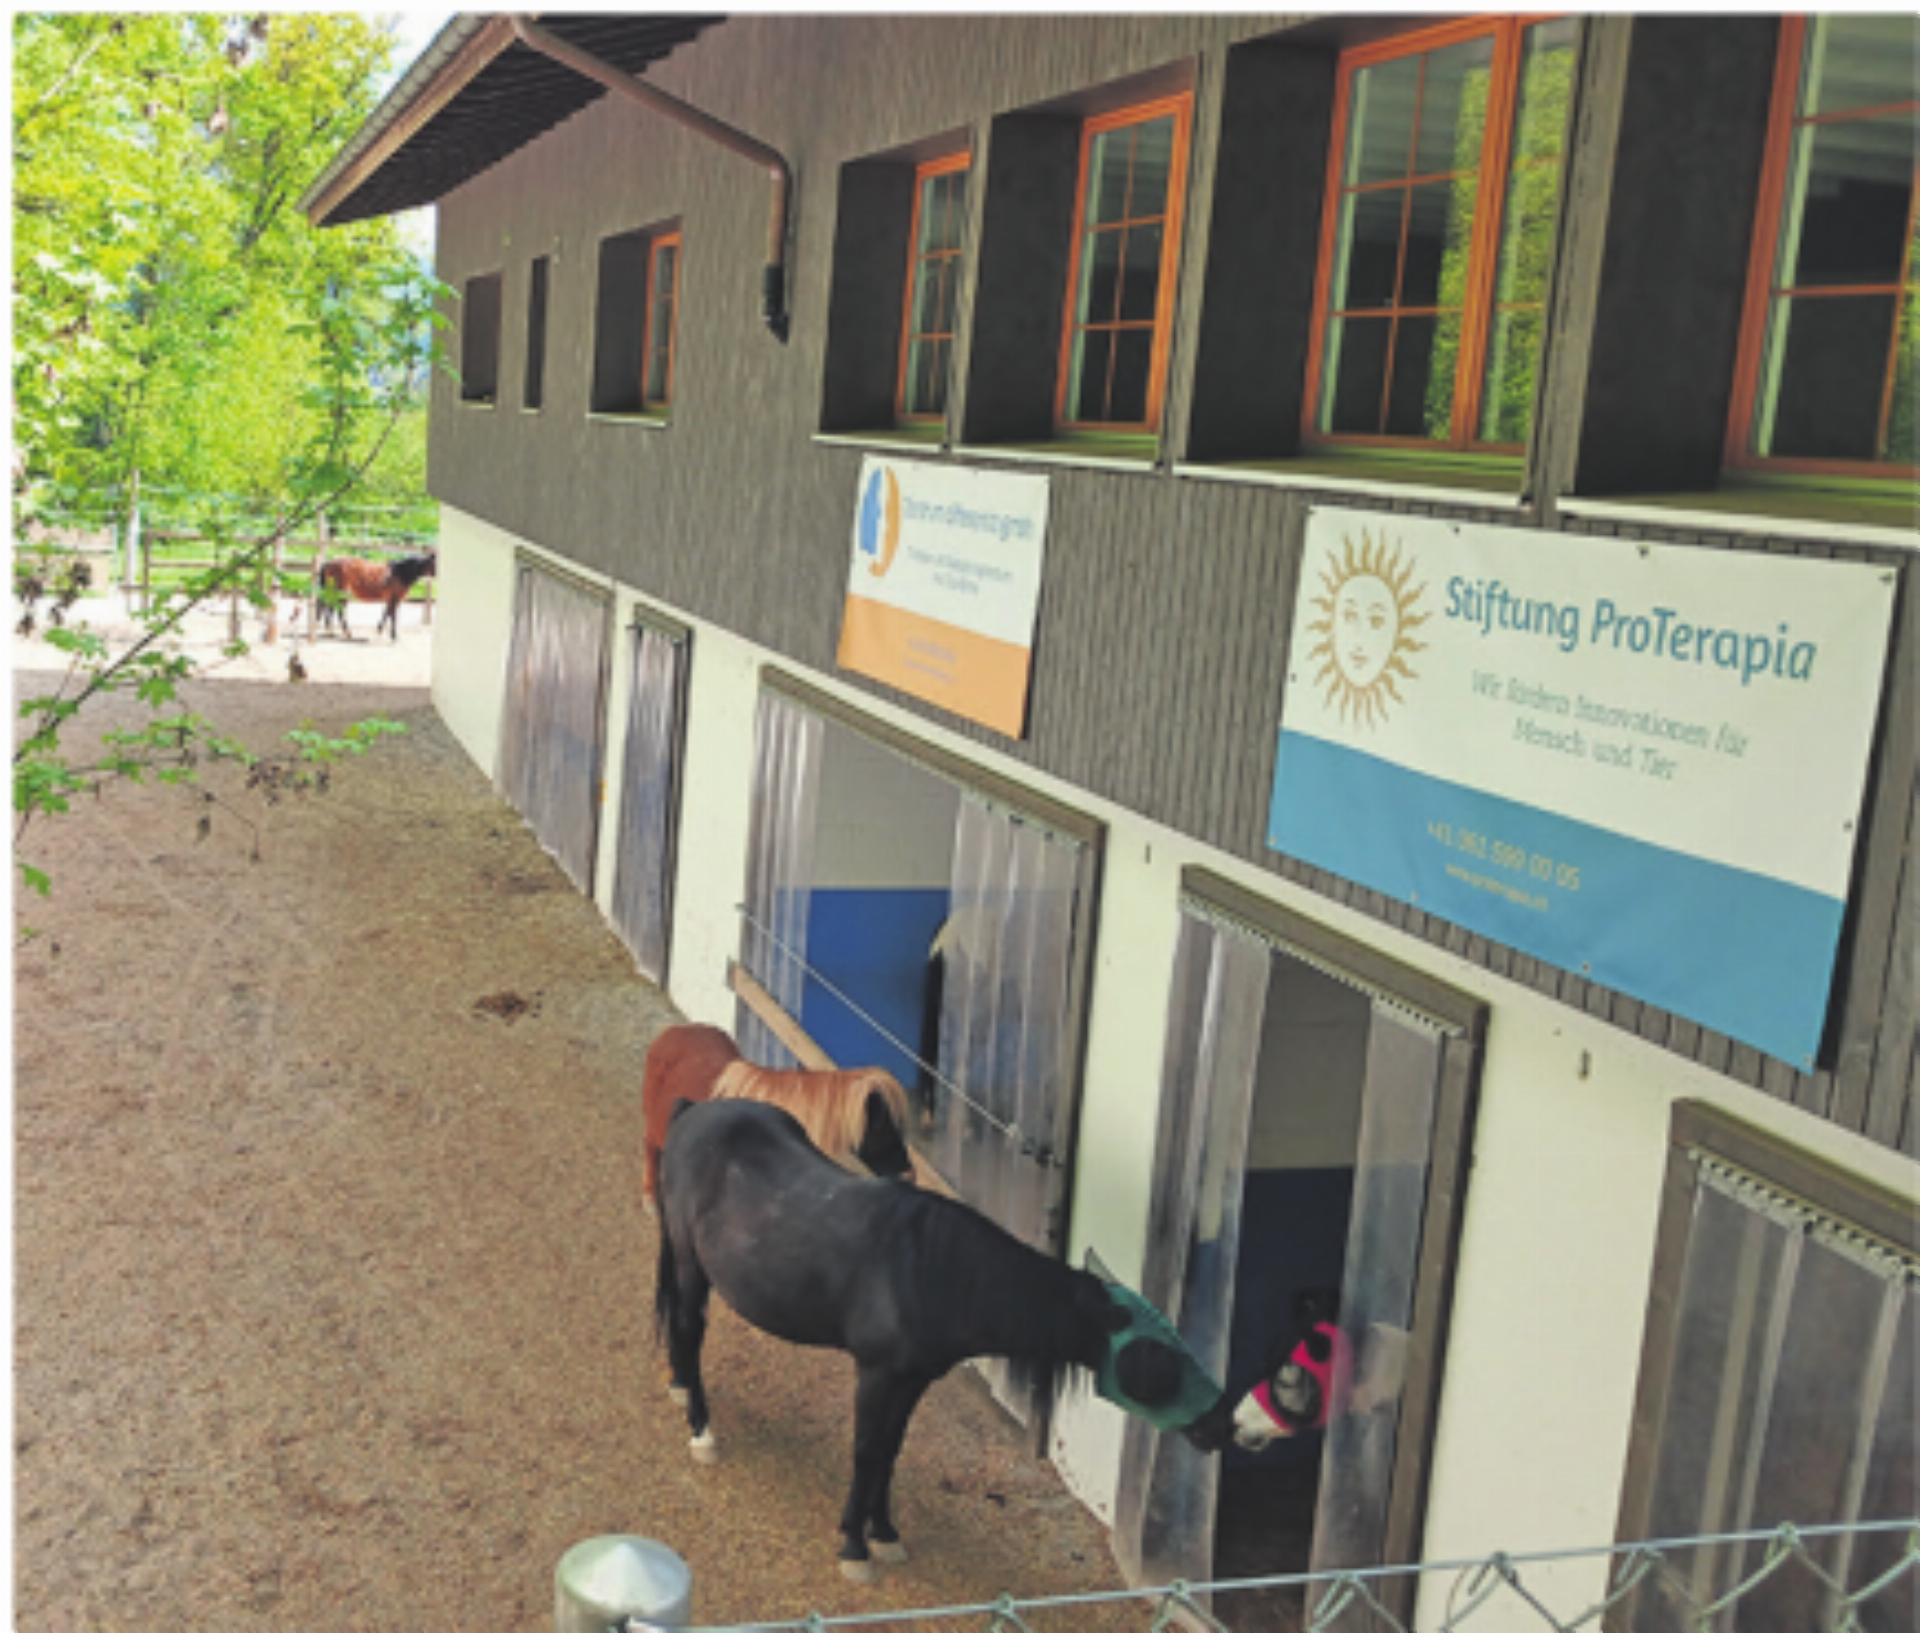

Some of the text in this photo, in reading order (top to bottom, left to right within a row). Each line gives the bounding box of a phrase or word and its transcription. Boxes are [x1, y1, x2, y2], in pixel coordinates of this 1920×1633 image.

[1445, 575, 1818, 686] Stiftung ProTerapia
[1513, 717, 1678, 780] Mensch und Tier
[1574, 694, 1709, 750] Innovationen
